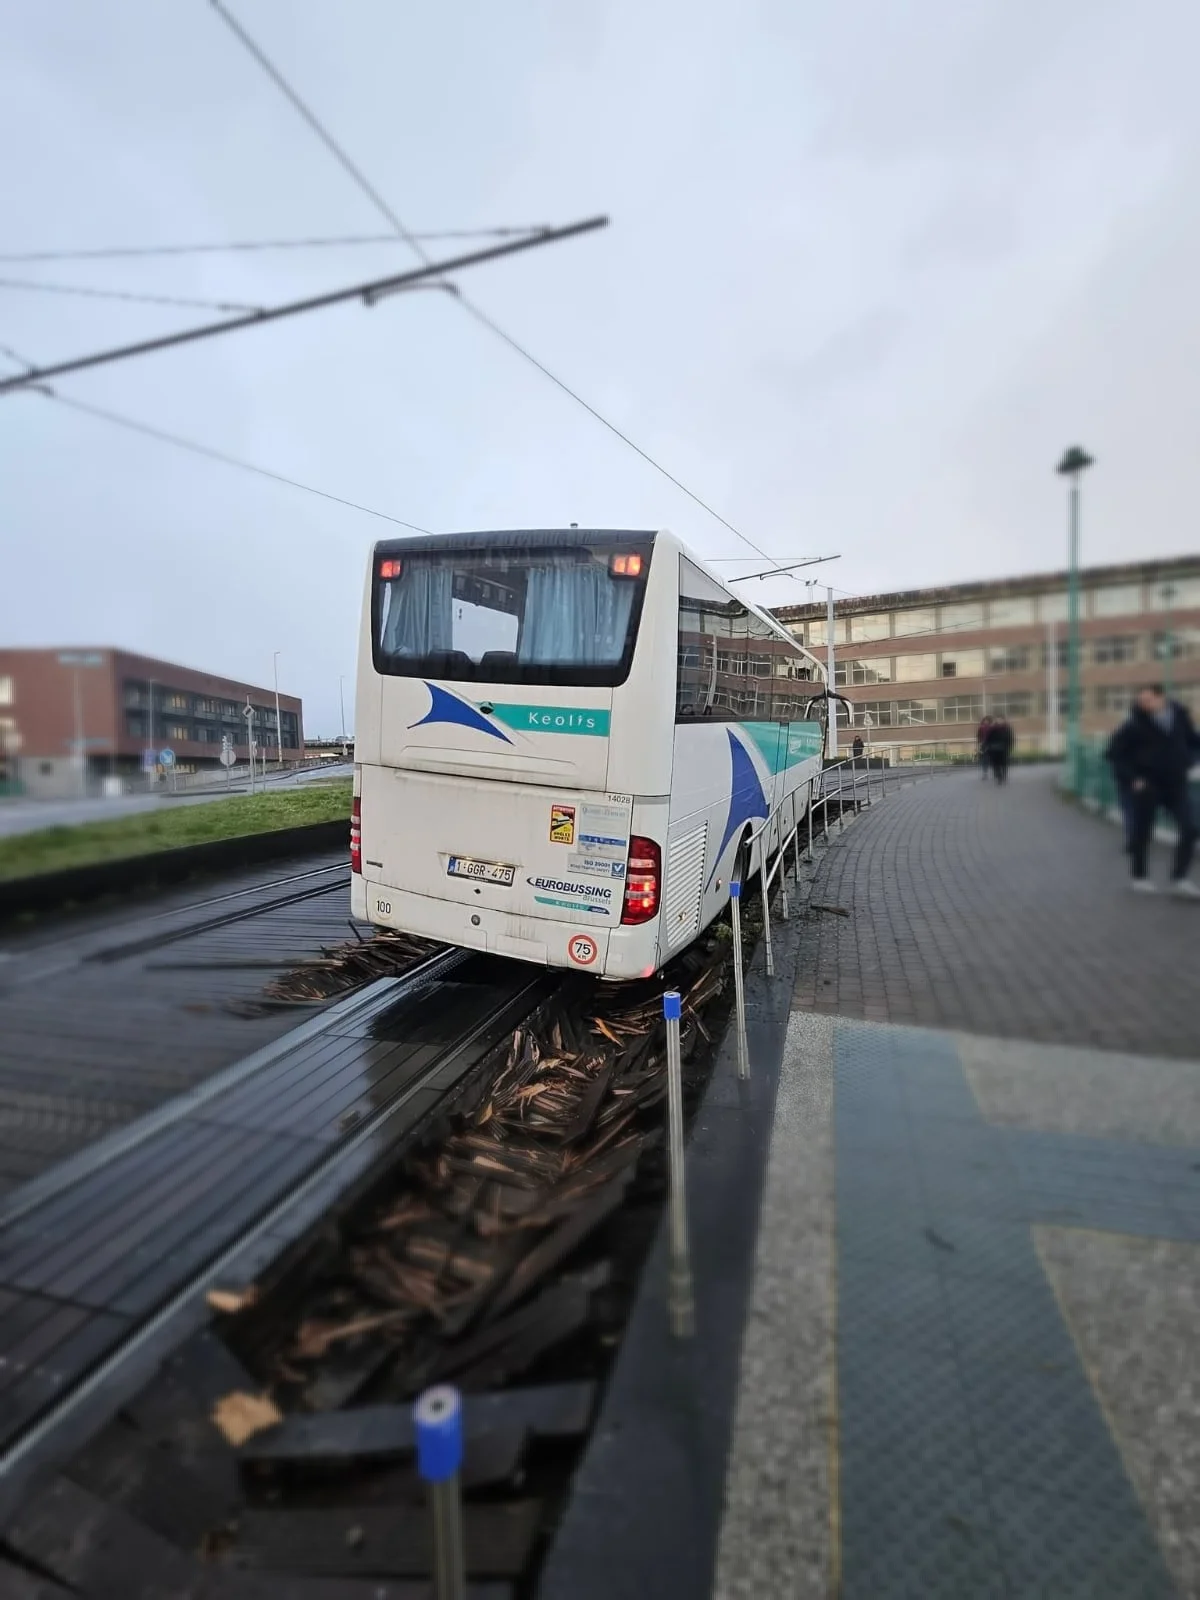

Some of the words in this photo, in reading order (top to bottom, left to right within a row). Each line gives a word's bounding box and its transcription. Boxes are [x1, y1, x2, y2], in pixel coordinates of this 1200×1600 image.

[528, 711, 596, 728] Keolis
[535, 878, 612, 898] EUROBUSSING
[376, 900, 391, 914] 100
[583, 895, 611, 905] Brussels
[575, 942, 591, 955] 75
